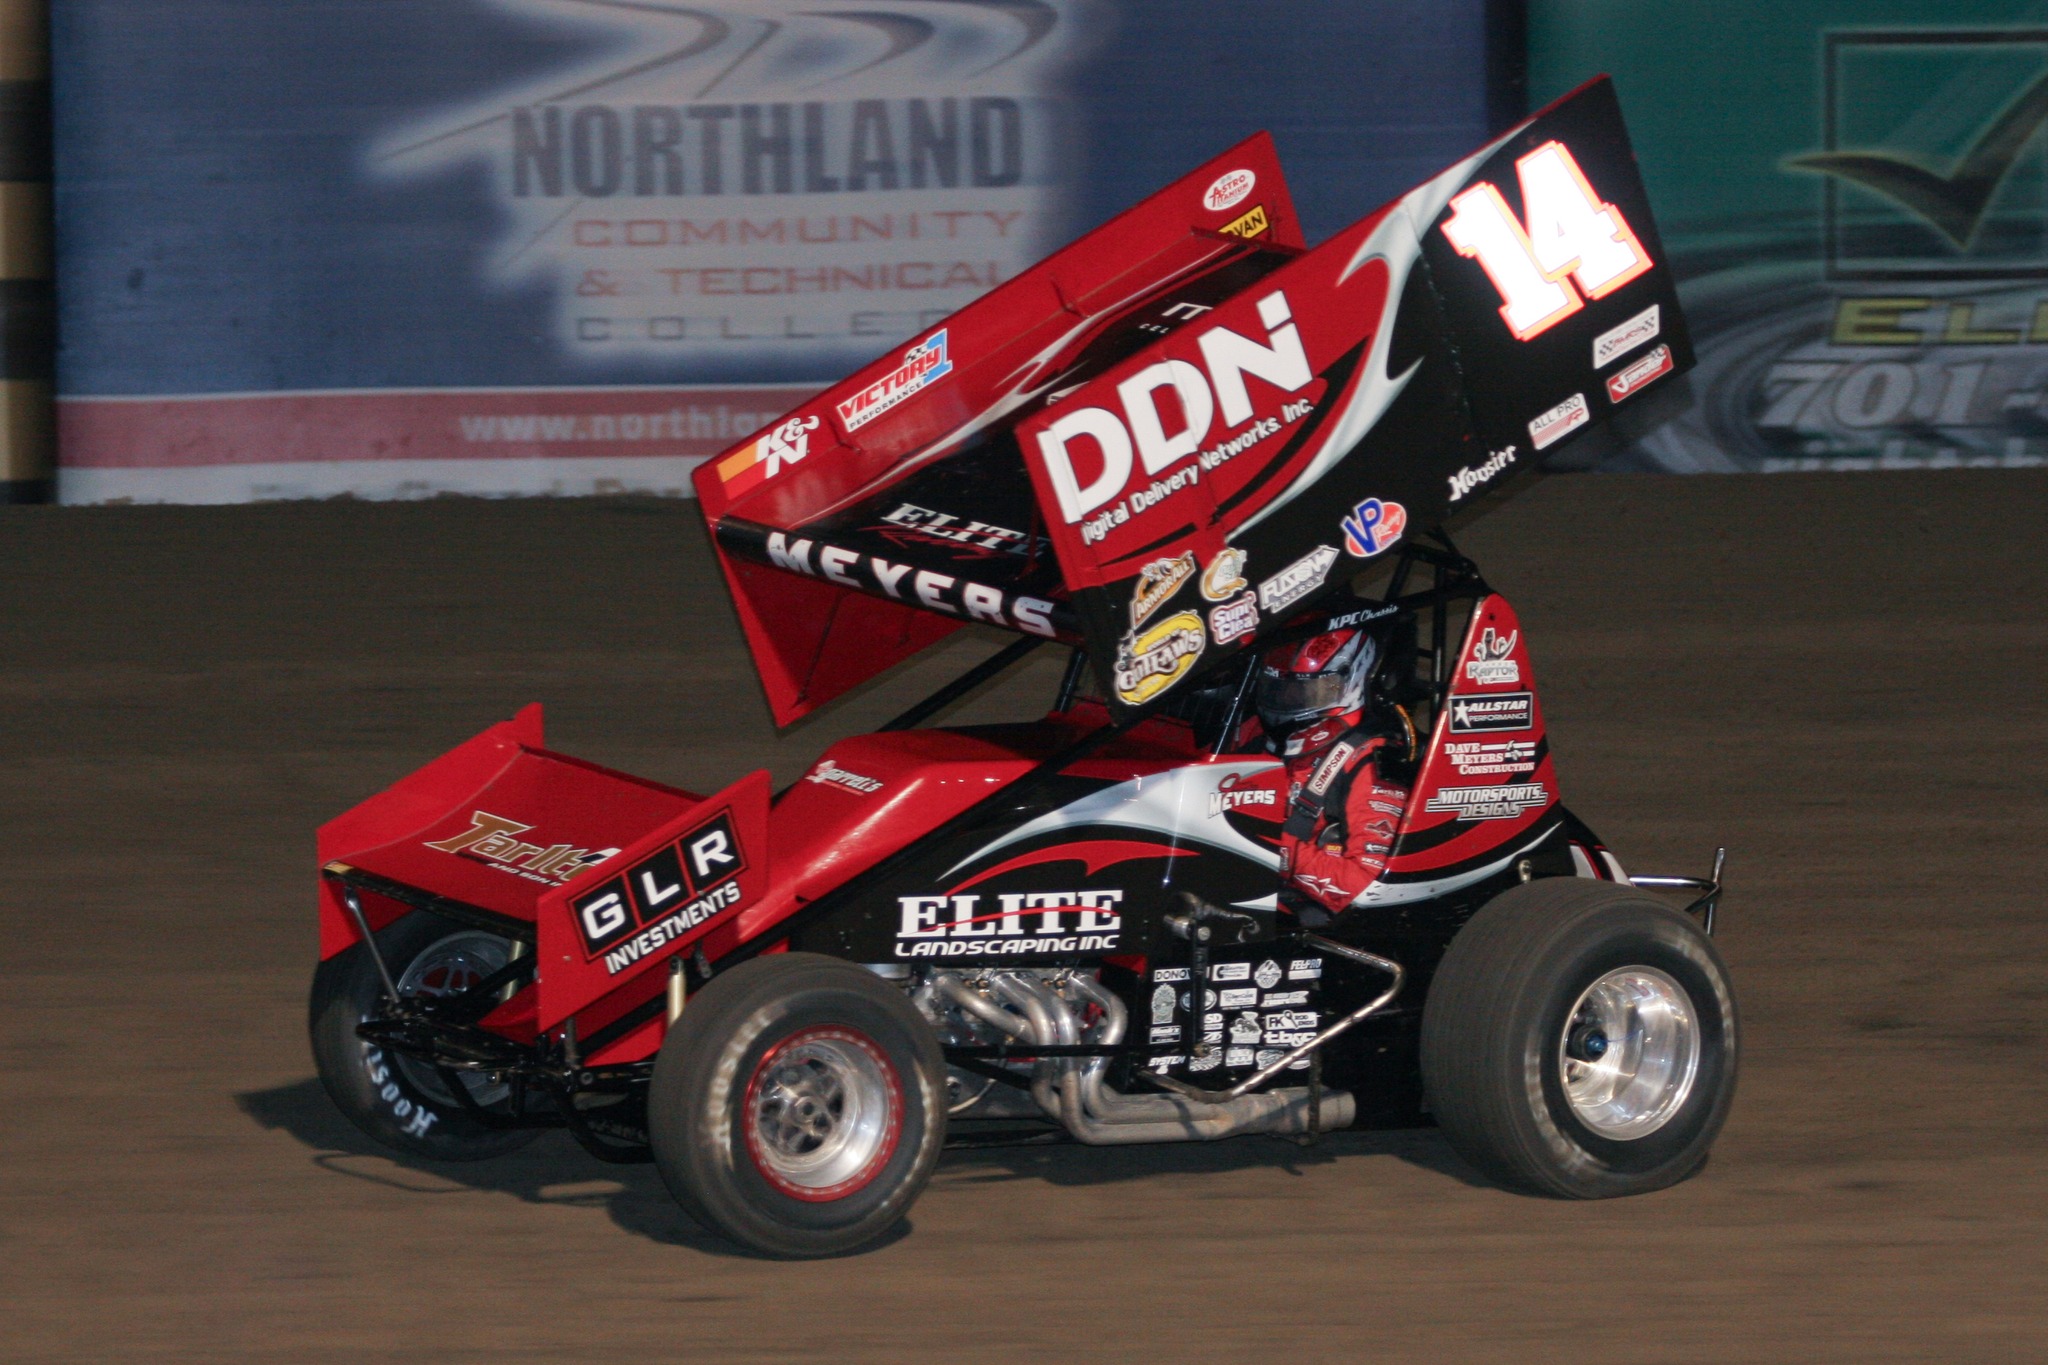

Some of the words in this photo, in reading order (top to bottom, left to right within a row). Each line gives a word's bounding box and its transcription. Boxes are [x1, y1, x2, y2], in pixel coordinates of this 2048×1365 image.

[511, 97, 1023, 199] NORTHLAND
[573, 209, 1022, 247] COMMUNITY
[1441, 141, 1653, 341] 14
[575, 268, 619, 298] &
[656, 260, 1005, 296] TECHNICAL
[840, 347, 941, 420] VICTORY
[849, 381, 923, 430] PERFORMANCE
[1534, 413, 1557, 432] ALL
[1556, 396, 1581, 417] PRO
[1129, 463, 1199, 514] Delivery
[1447, 445, 1517, 501] Hoosier
[1341, 498, 1384, 555] VP
[766, 531, 1056, 638] MEYERS
[1327, 612, 1361, 631] KPC
[1467, 700, 1528, 713] ALLSTAR
[1468, 712, 1528, 722] PERFORMANCE
[1444, 742, 1481, 755] DAVE
[1450, 753, 1505, 765] MEYERS
[1315, 747, 1347, 790] SIMPSON
[1458, 762, 1536, 775] CONSTRUCTION
[1207, 789, 1276, 819] MEYERS
[1438, 785, 1542, 805] MOTORSPORTS
[1461, 802, 1521, 817] DESIGNS
[487, 862, 519, 875] AND
[604, 881, 741, 975] INVESTMENTS
[896, 889, 1123, 938] ELITE
[894, 937, 1078, 957] LANDSCAPING
[1079, 934, 1120, 950] INC
